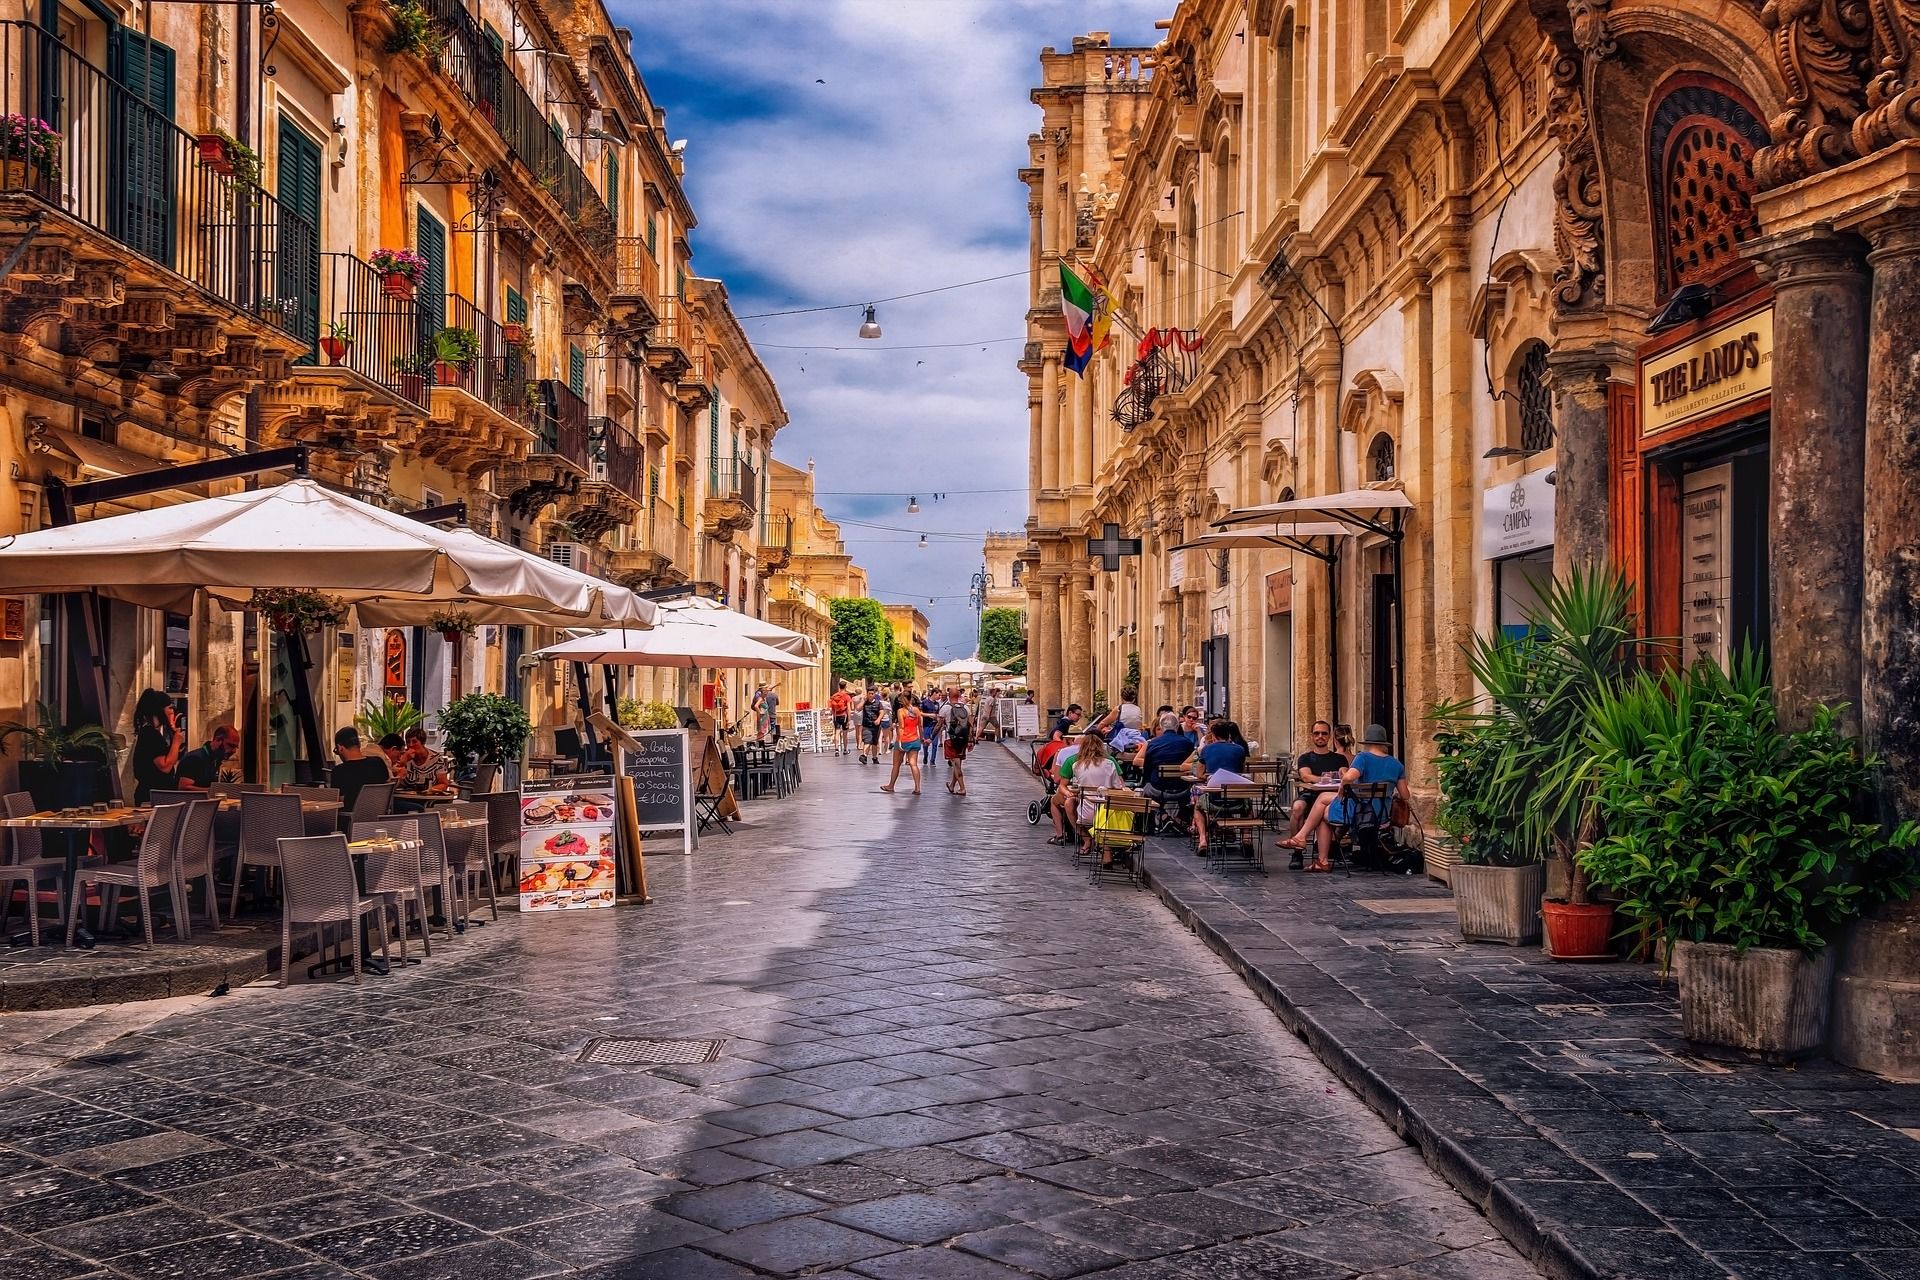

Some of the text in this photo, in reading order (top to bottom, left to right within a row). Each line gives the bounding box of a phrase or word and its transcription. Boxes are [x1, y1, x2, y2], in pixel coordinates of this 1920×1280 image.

[1650, 362, 1689, 406] THE
[1689, 332, 1760, 392] LAND'S
[1503, 508, 1532, 532] CAMPISI
